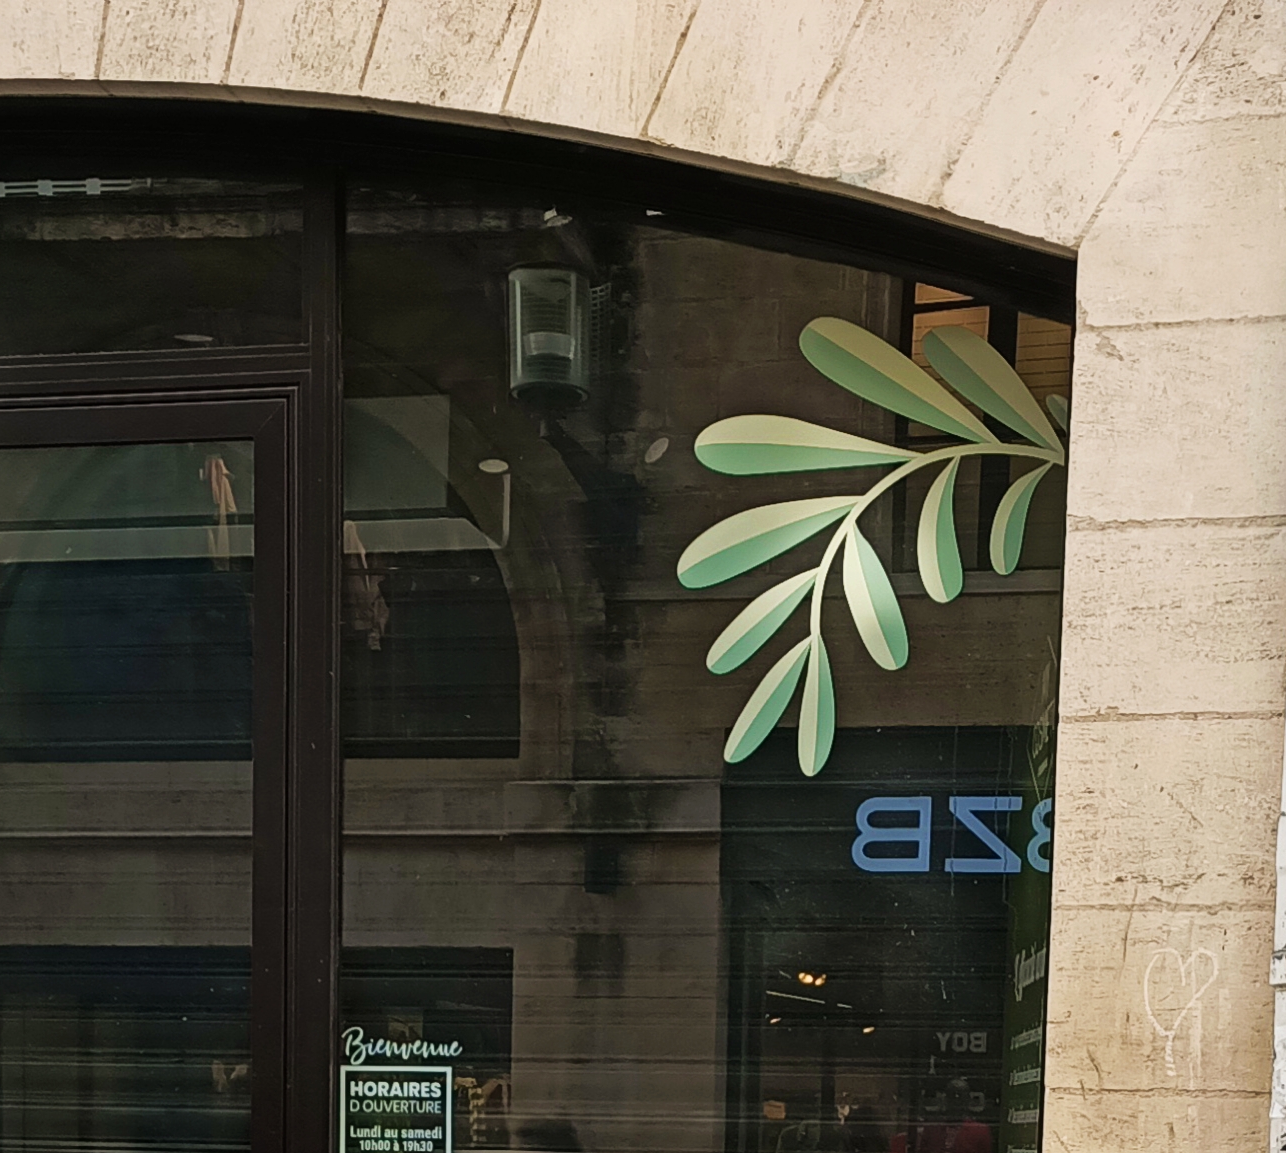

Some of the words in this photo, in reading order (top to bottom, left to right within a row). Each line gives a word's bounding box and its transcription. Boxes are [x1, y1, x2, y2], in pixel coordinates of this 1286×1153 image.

[341, 1026, 463, 1065] Bienvenue
[350, 1081, 442, 1098] HORAIRES
[350, 1125, 381, 1138] Lundi
[384, 1128, 398, 1138] au
[401, 1126, 442, 1139] samedi
[359, 1140, 390, 1151] 10h00
[393, 1140, 400, 1152] à
[402, 1141, 433, 1152] 19h30
